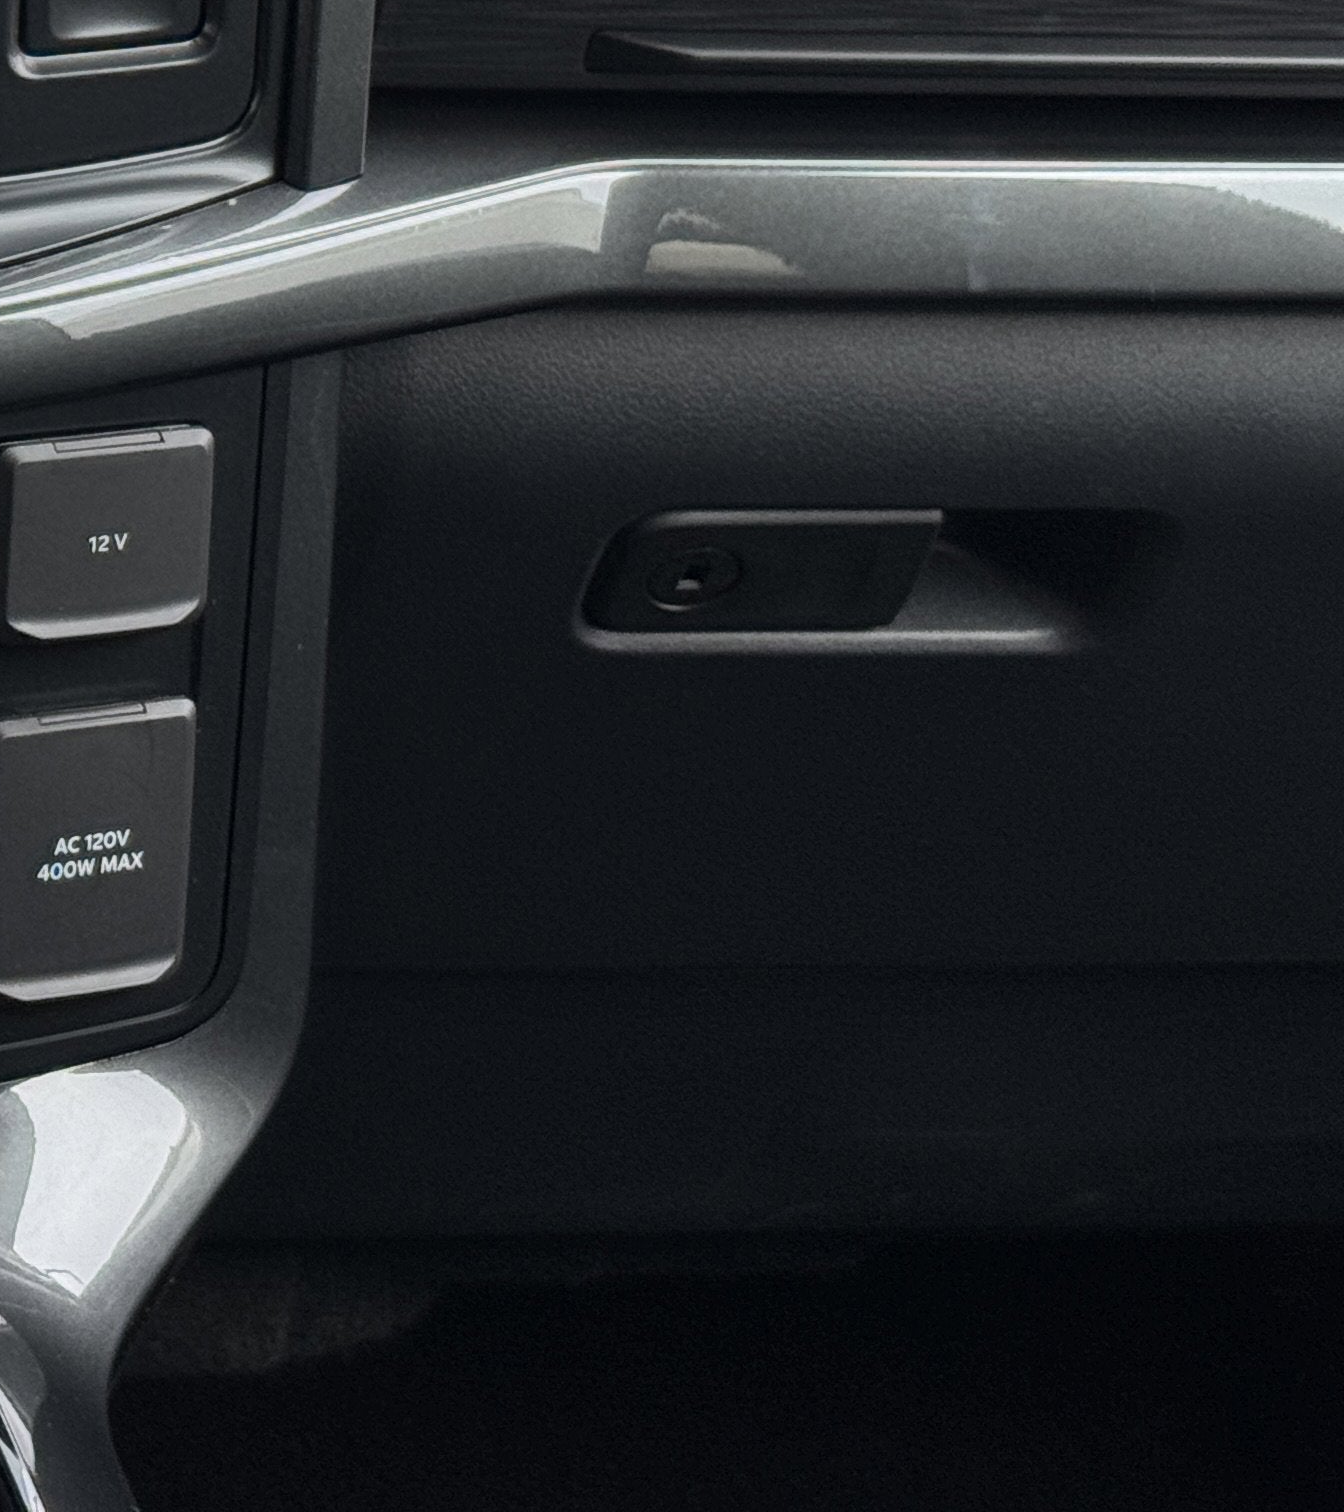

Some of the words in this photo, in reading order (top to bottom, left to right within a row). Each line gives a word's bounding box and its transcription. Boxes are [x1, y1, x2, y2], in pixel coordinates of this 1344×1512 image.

[88, 536, 111, 554] 12
[114, 533, 128, 552] V
[54, 835, 81, 856] AC
[85, 829, 131, 851] 120V
[36, 859, 96, 882] 400W
[100, 851, 145, 874] MAX
